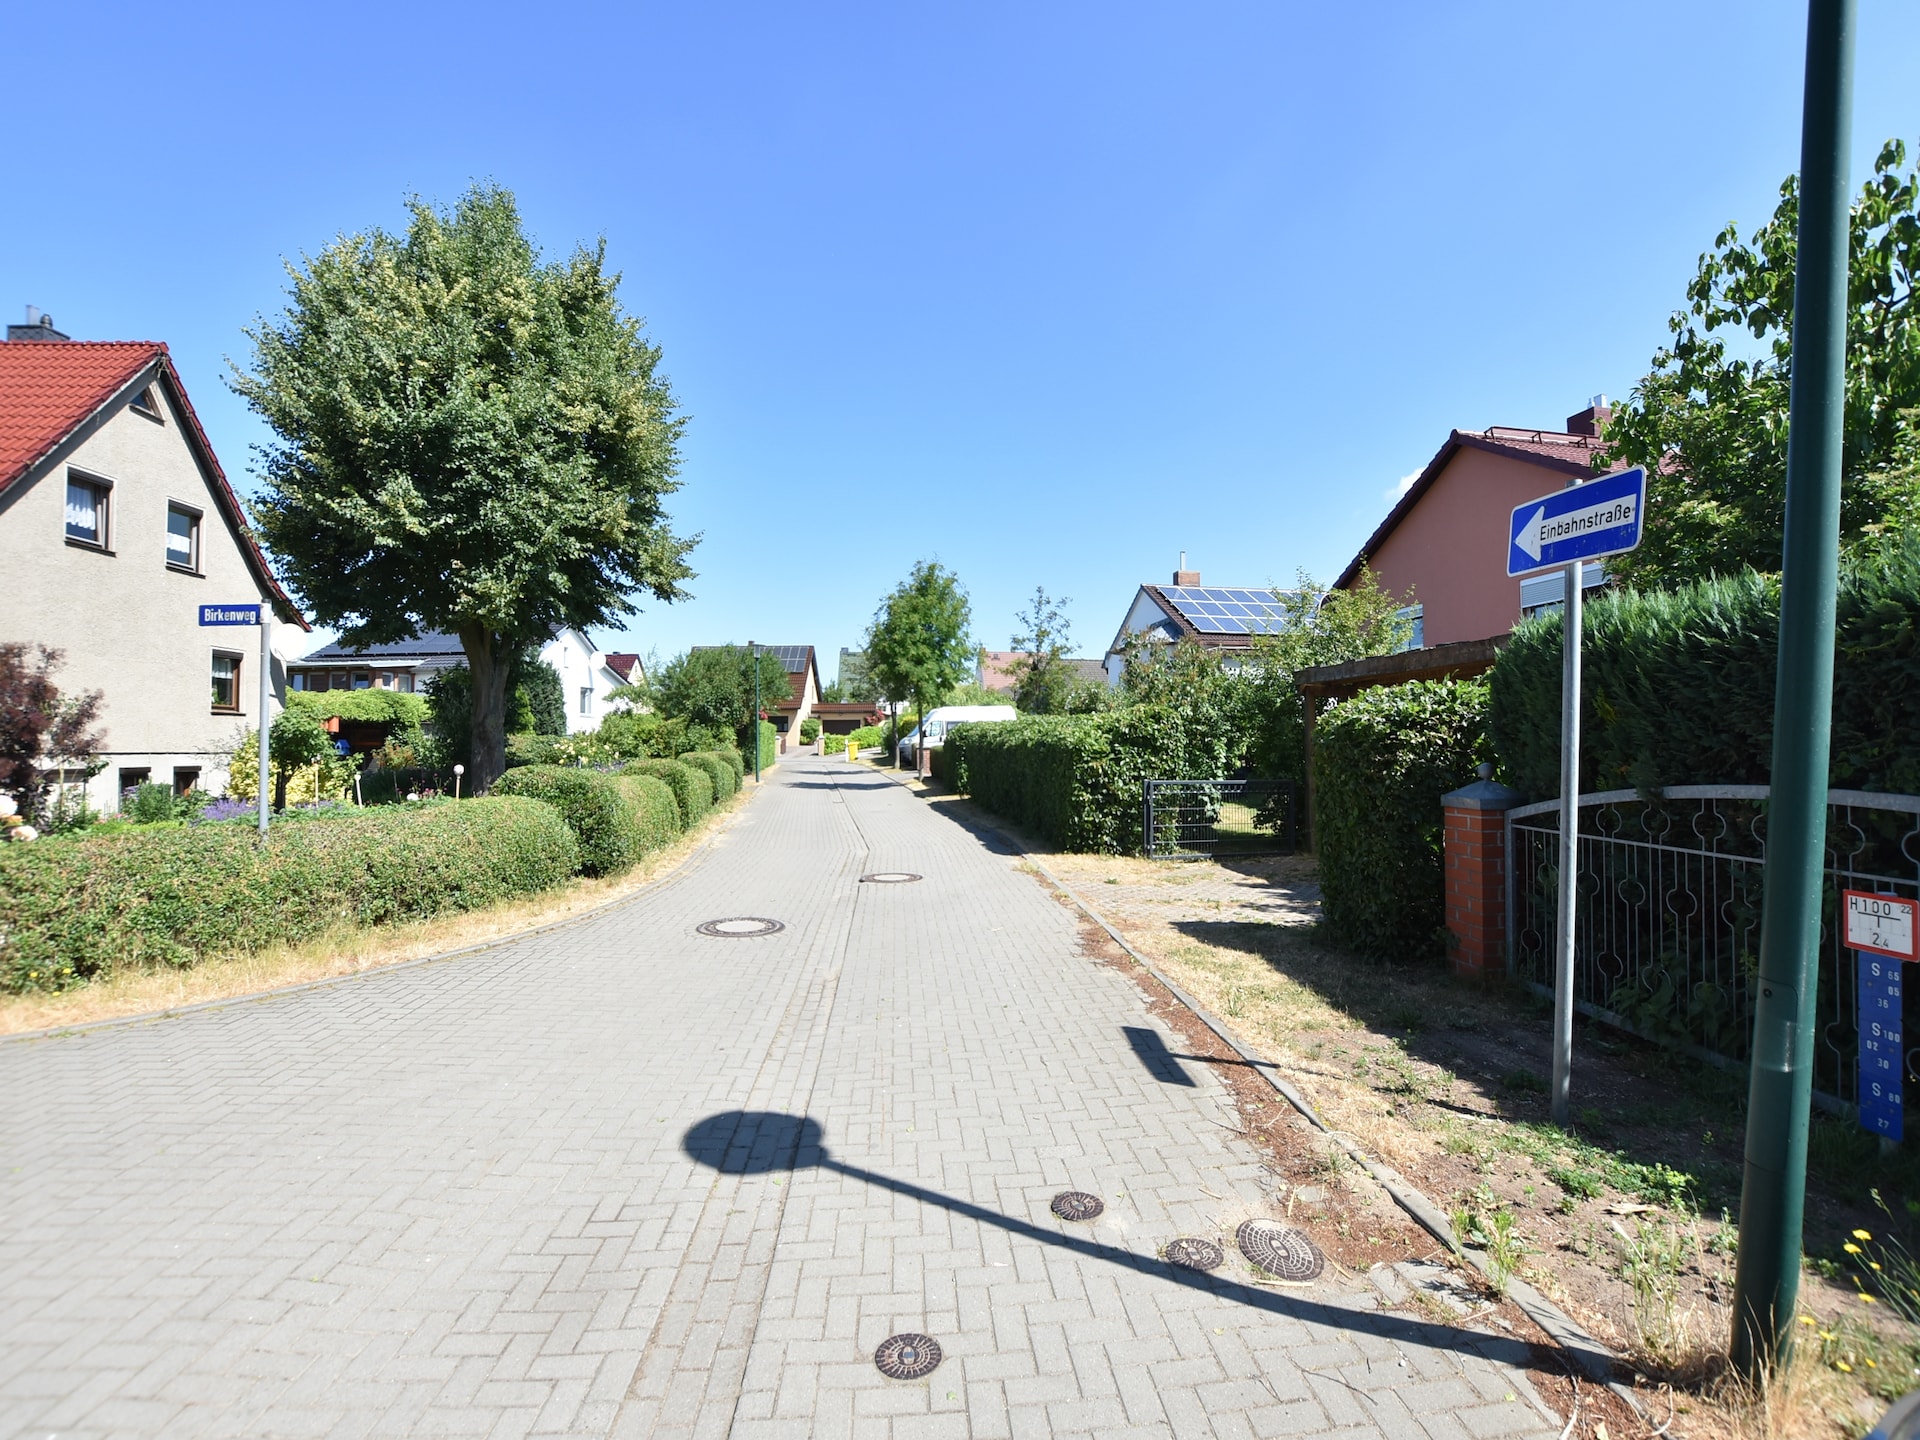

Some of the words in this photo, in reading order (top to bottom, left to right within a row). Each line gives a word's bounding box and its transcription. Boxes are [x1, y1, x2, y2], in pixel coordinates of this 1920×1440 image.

[1540, 504, 1631, 541] Einbahnstraße
[204, 608, 256, 624] Birkenweg
[1871, 962, 1881, 977] S
[1871, 1022, 1881, 1037] S
[1871, 1082, 1881, 1097] S
